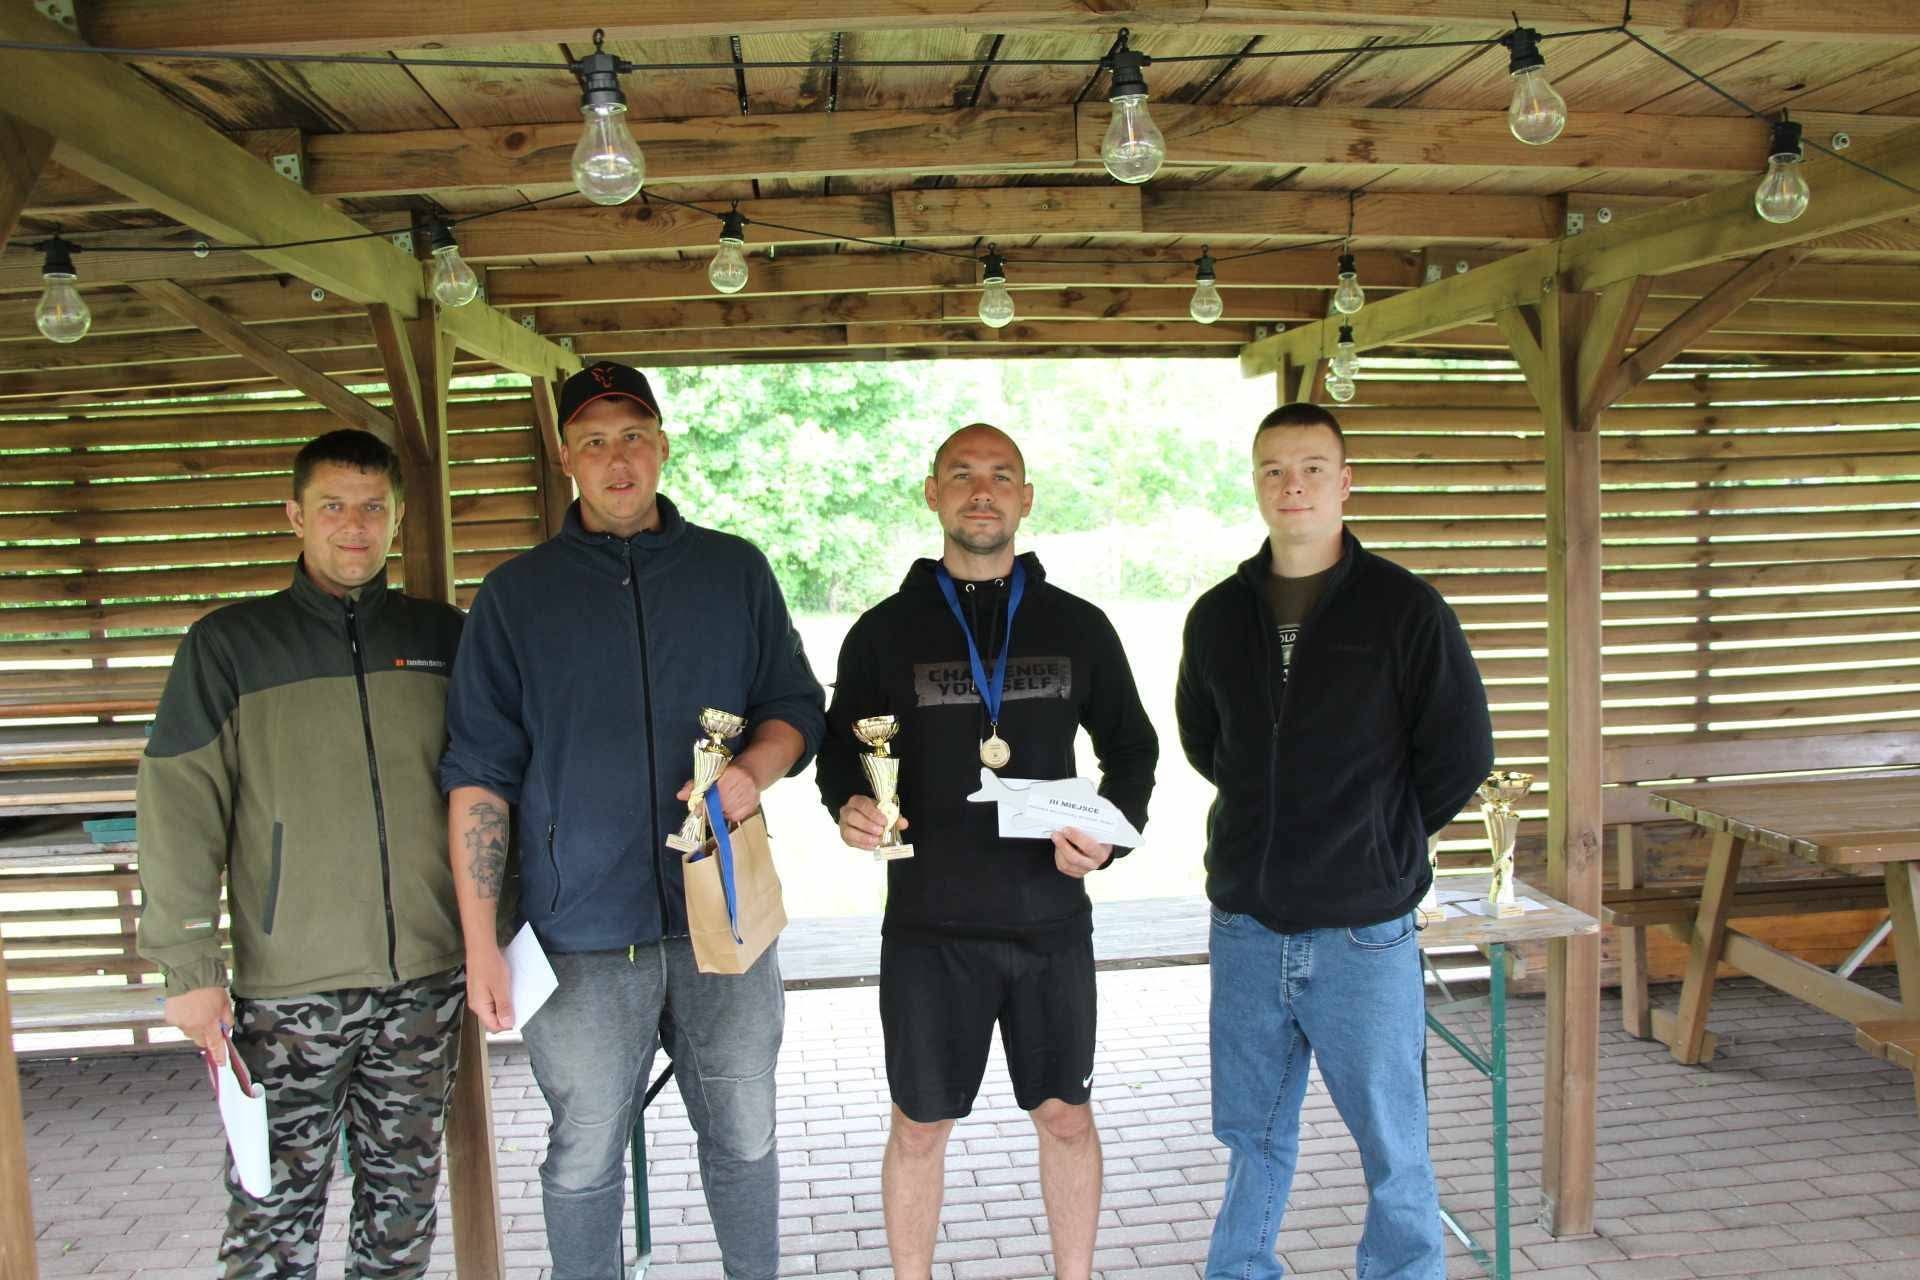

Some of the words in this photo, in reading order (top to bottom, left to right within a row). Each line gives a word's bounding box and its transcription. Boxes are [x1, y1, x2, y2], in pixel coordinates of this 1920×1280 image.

[928, 663, 1059, 683] CHAENGE
[938, 676, 1052, 696] YOUSELF
[1061, 800, 1100, 814] MIEJSCE
